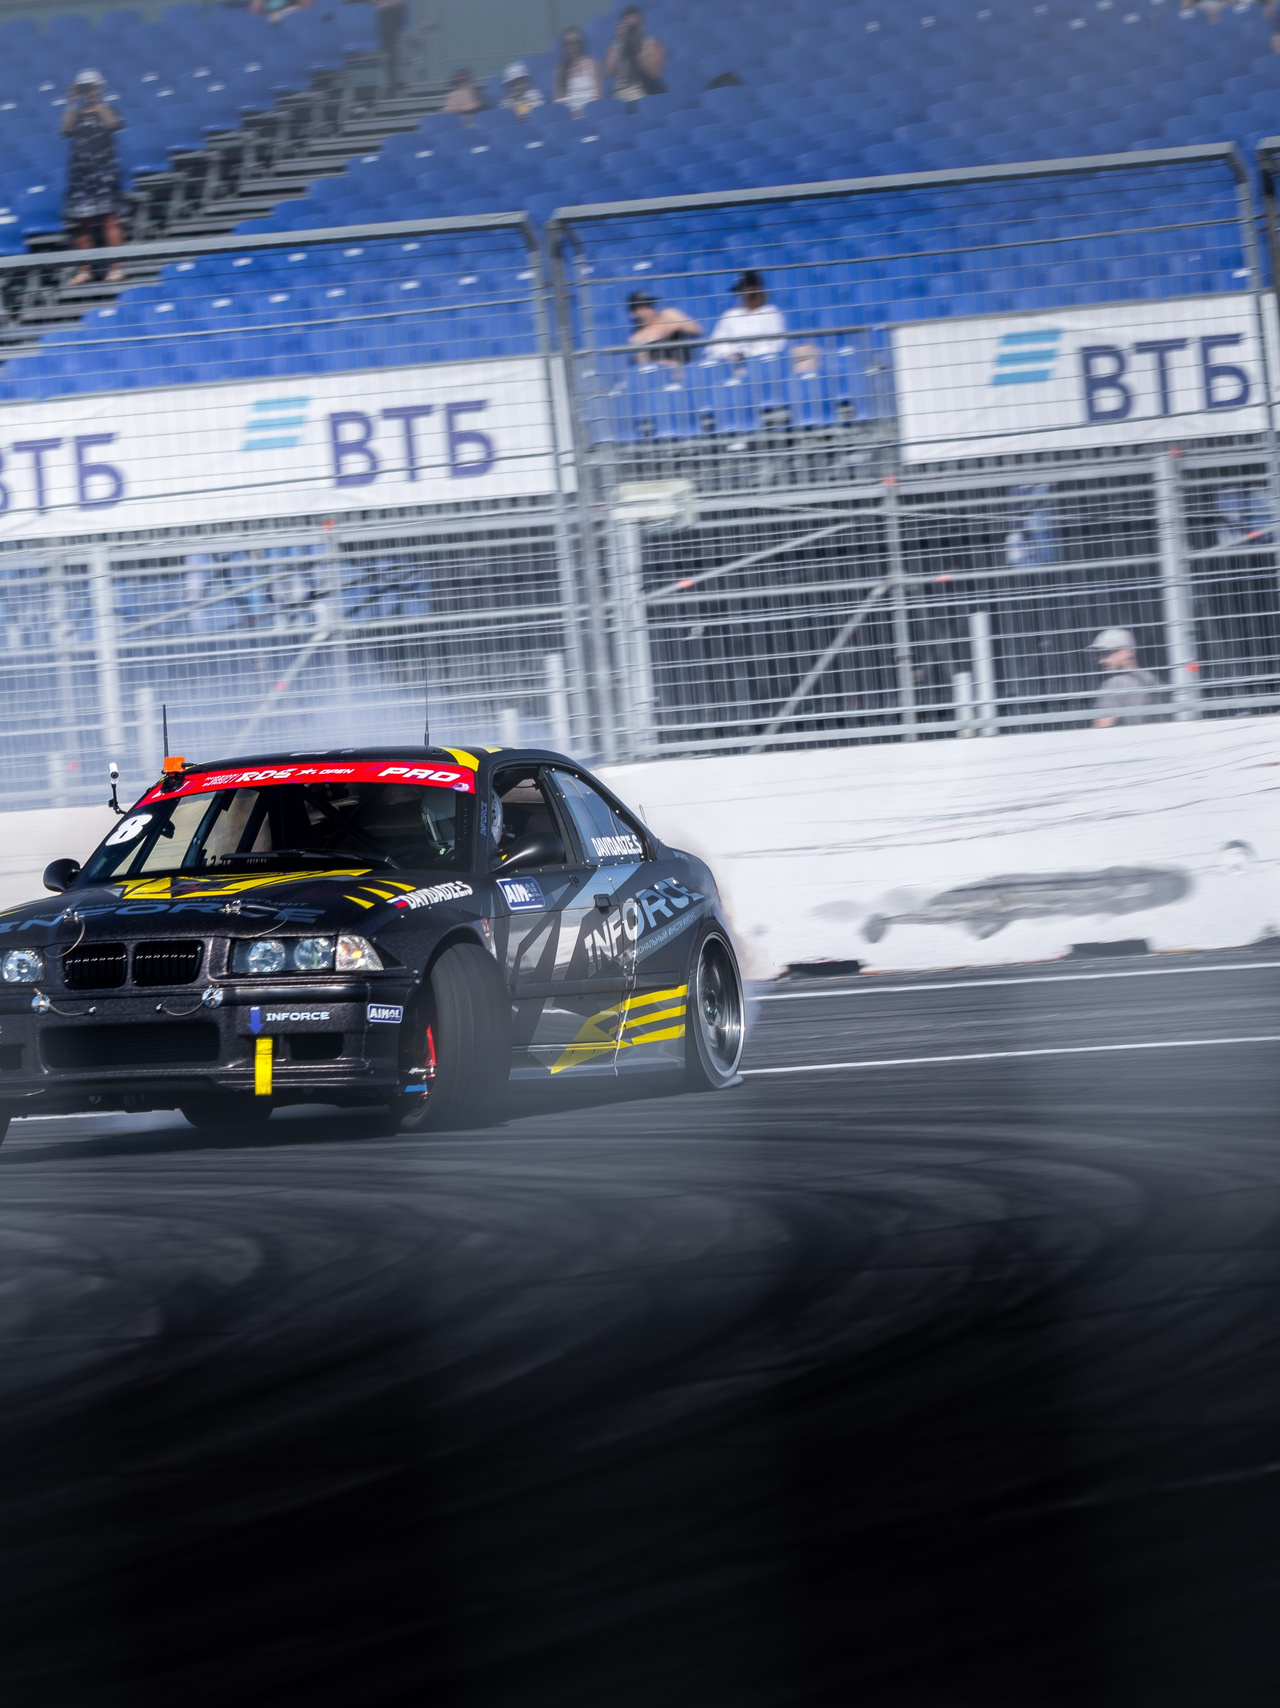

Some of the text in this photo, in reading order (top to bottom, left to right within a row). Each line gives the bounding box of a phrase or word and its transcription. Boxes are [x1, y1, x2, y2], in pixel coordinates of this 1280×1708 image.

[1080, 332, 1251, 423] ВТБ
[328, 399, 499, 489] ВТБ
[235, 768, 298, 783] RDS
[377, 767, 461, 782] PRO
[105, 813, 153, 846] 8
[265, 1012, 330, 1021] INFORCE
